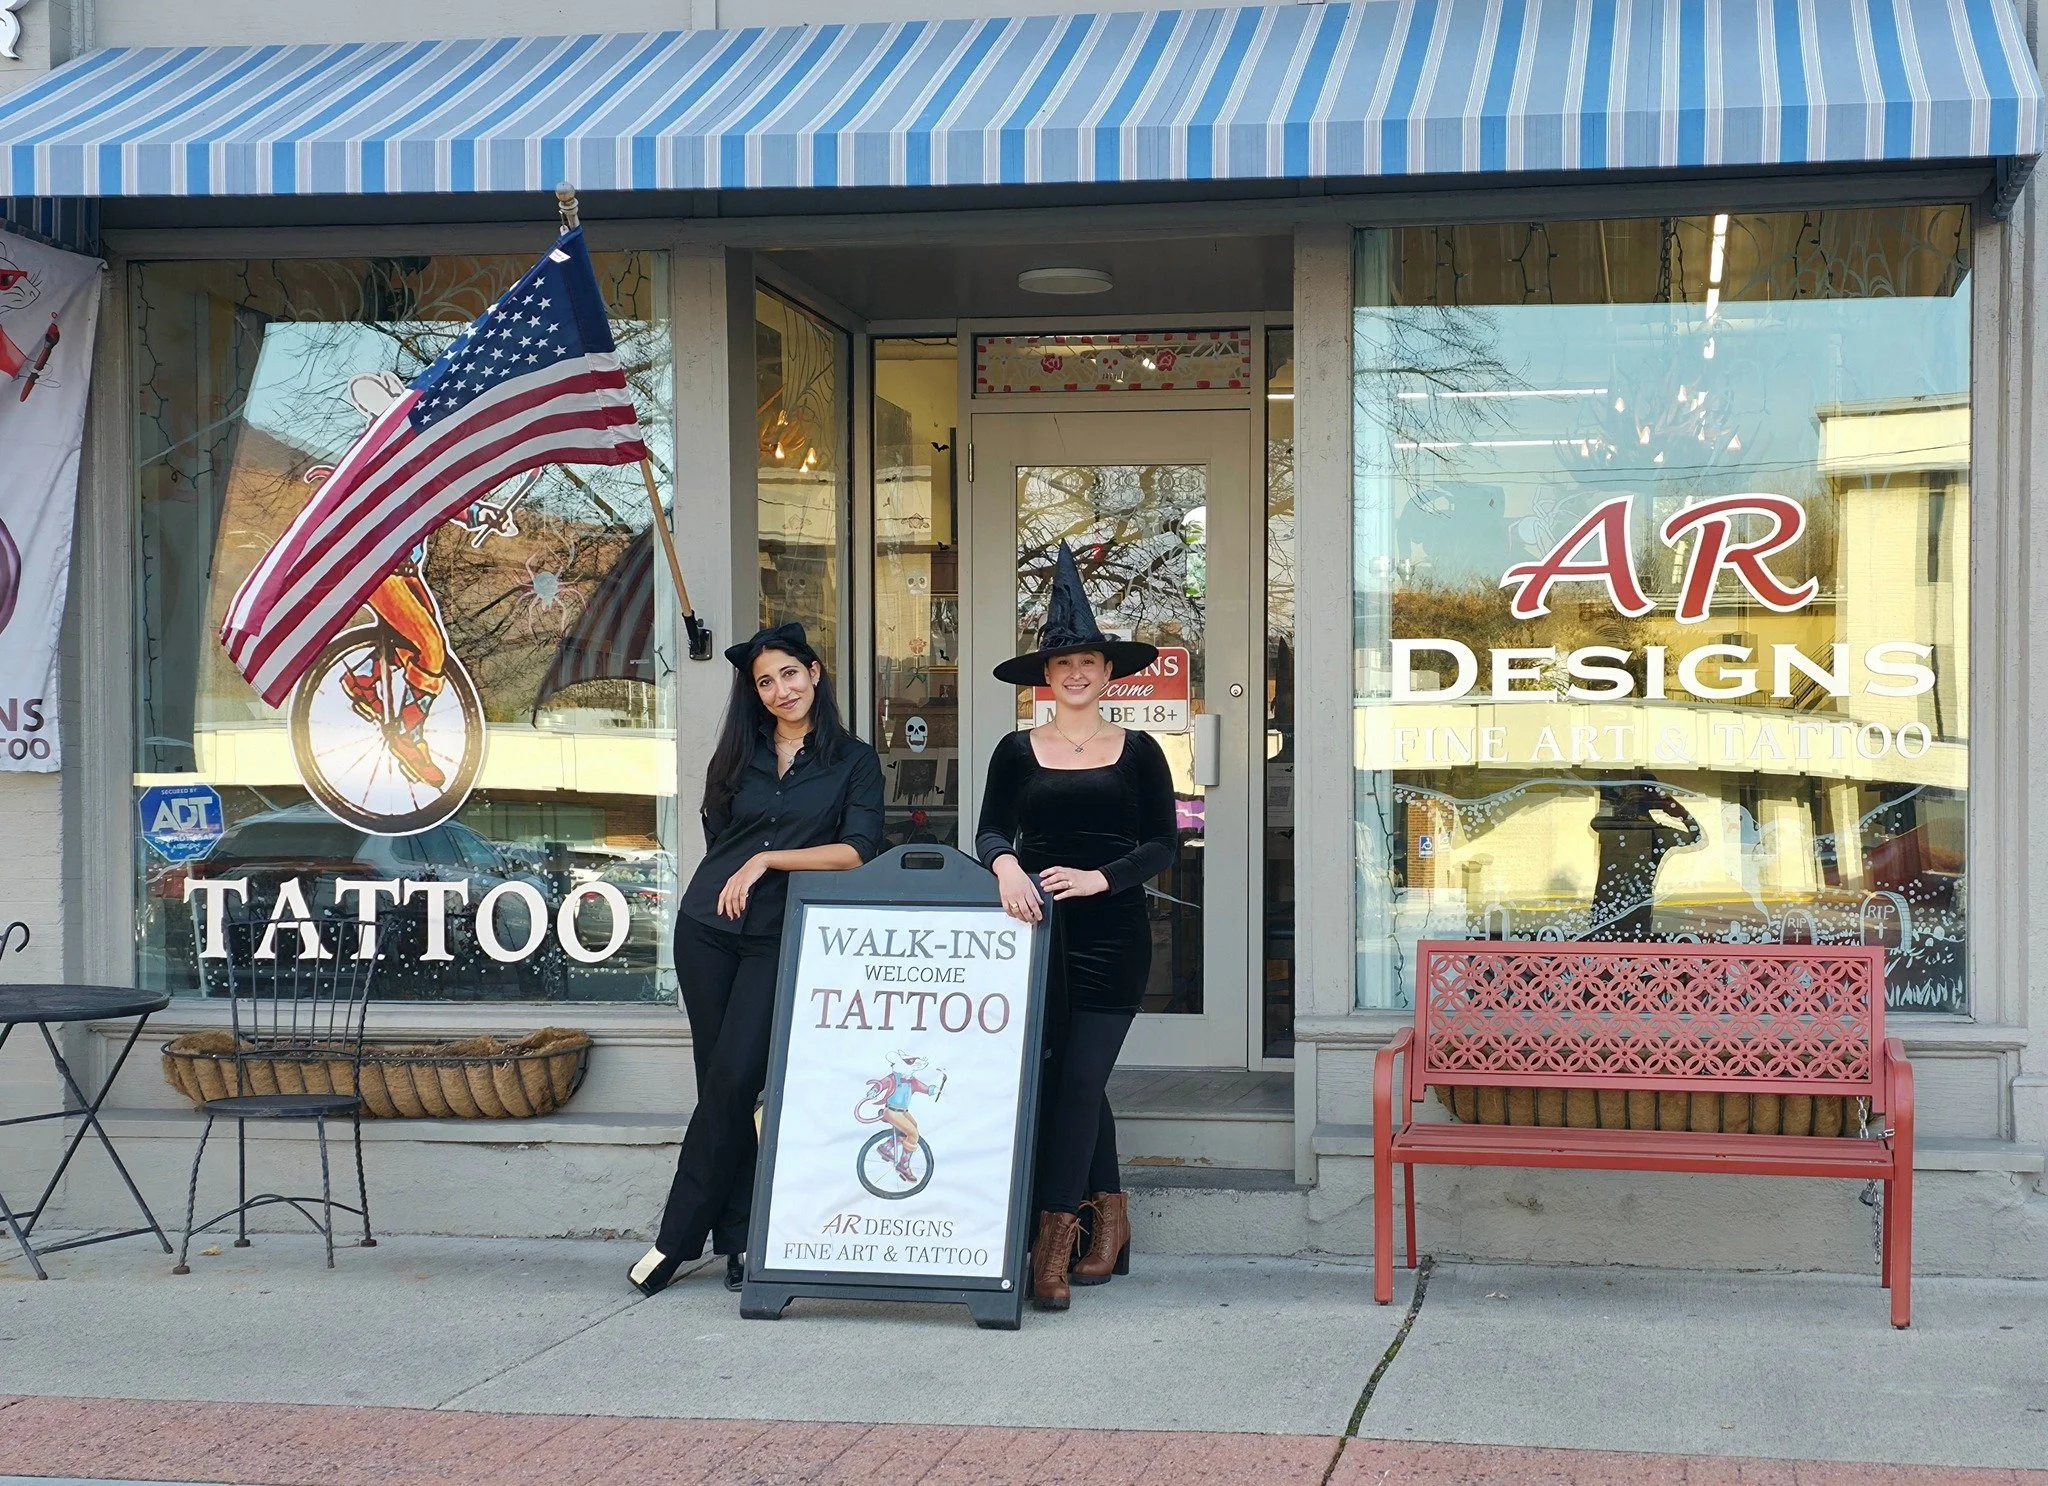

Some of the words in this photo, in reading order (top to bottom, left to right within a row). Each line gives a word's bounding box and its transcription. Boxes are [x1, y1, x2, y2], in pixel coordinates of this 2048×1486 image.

[1499, 493, 1819, 625] AR
[1388, 638, 1936, 702] DESIGNS
[1109, 707, 1135, 723] BE
[1143, 705, 1177, 723] 18+
[1391, 725, 1510, 763] FINE
[1530, 723, 1636, 763] ART
[1654, 723, 1697, 762] &
[1713, 720, 1932, 760] TATTOO
[150, 796, 213, 833] ADT
[183, 876, 631, 963] TATTOO
[1787, 917, 1807, 929] RIP
[1864, 904, 1896, 921] RIP
[818, 926, 1017, 960] WALK-INS
[864, 965, 966, 983] WELCOME
[810, 988, 1011, 1034] TATTOO
[821, 1213, 862, 1235] AR
[864, 1218, 954, 1238] DESIGNS
[783, 1242, 832, 1261] FINE
[835, 1244, 878, 1262] ART
[883, 1245, 899, 1263] &
[904, 1245, 988, 1266] TATTOO
